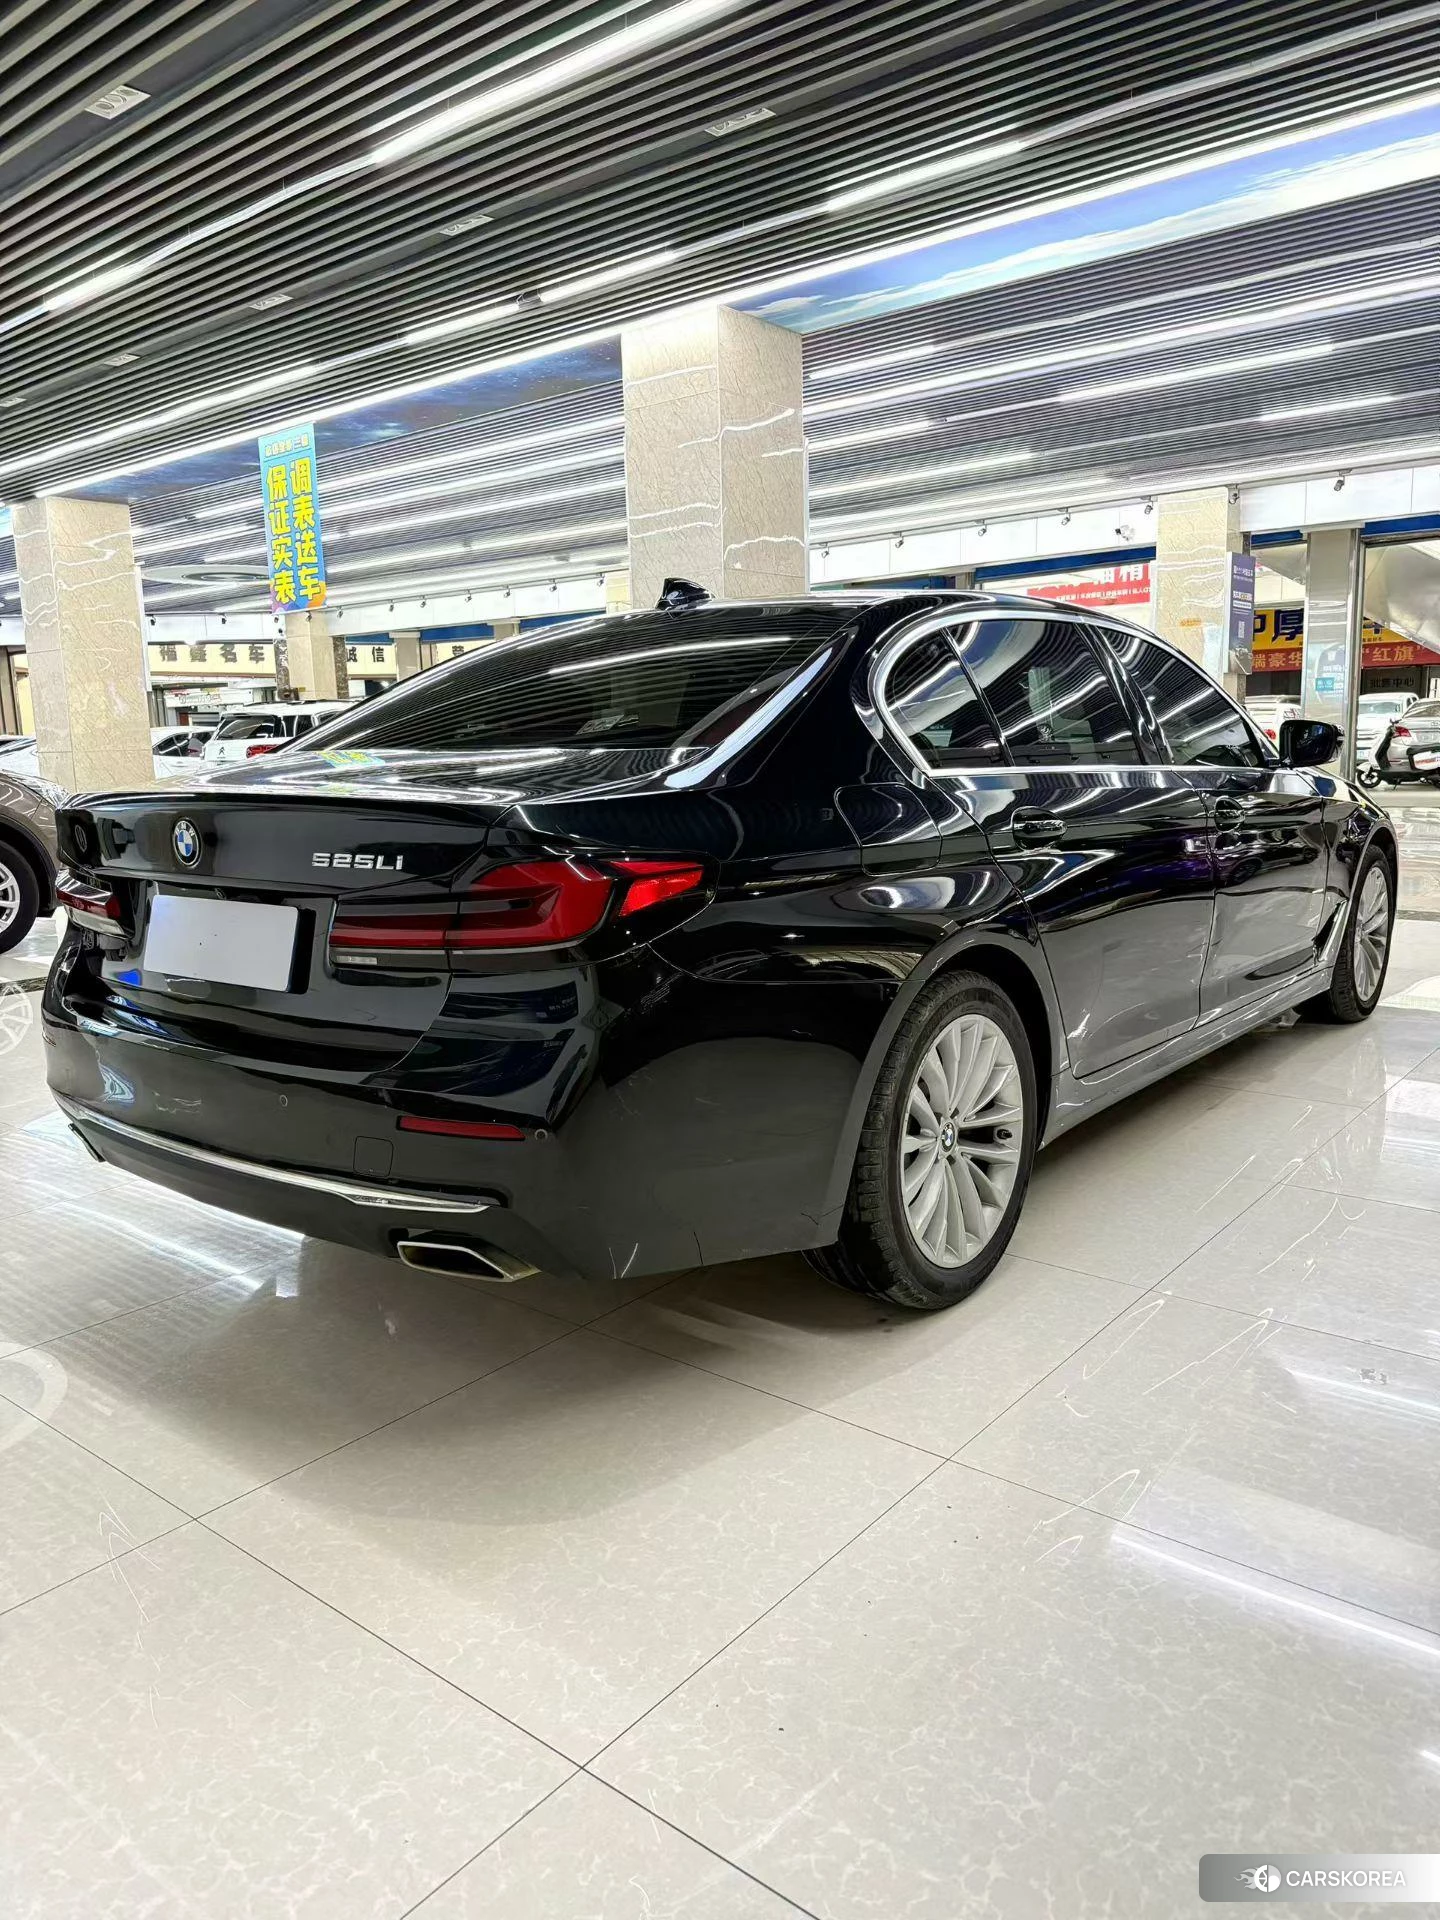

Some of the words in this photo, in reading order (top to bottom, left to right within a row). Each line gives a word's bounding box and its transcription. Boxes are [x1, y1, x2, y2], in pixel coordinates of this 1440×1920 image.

[266, 464, 297, 605] 保证实表
[289, 456, 321, 601] 调表送车
[312, 852, 404, 870] 525Li
